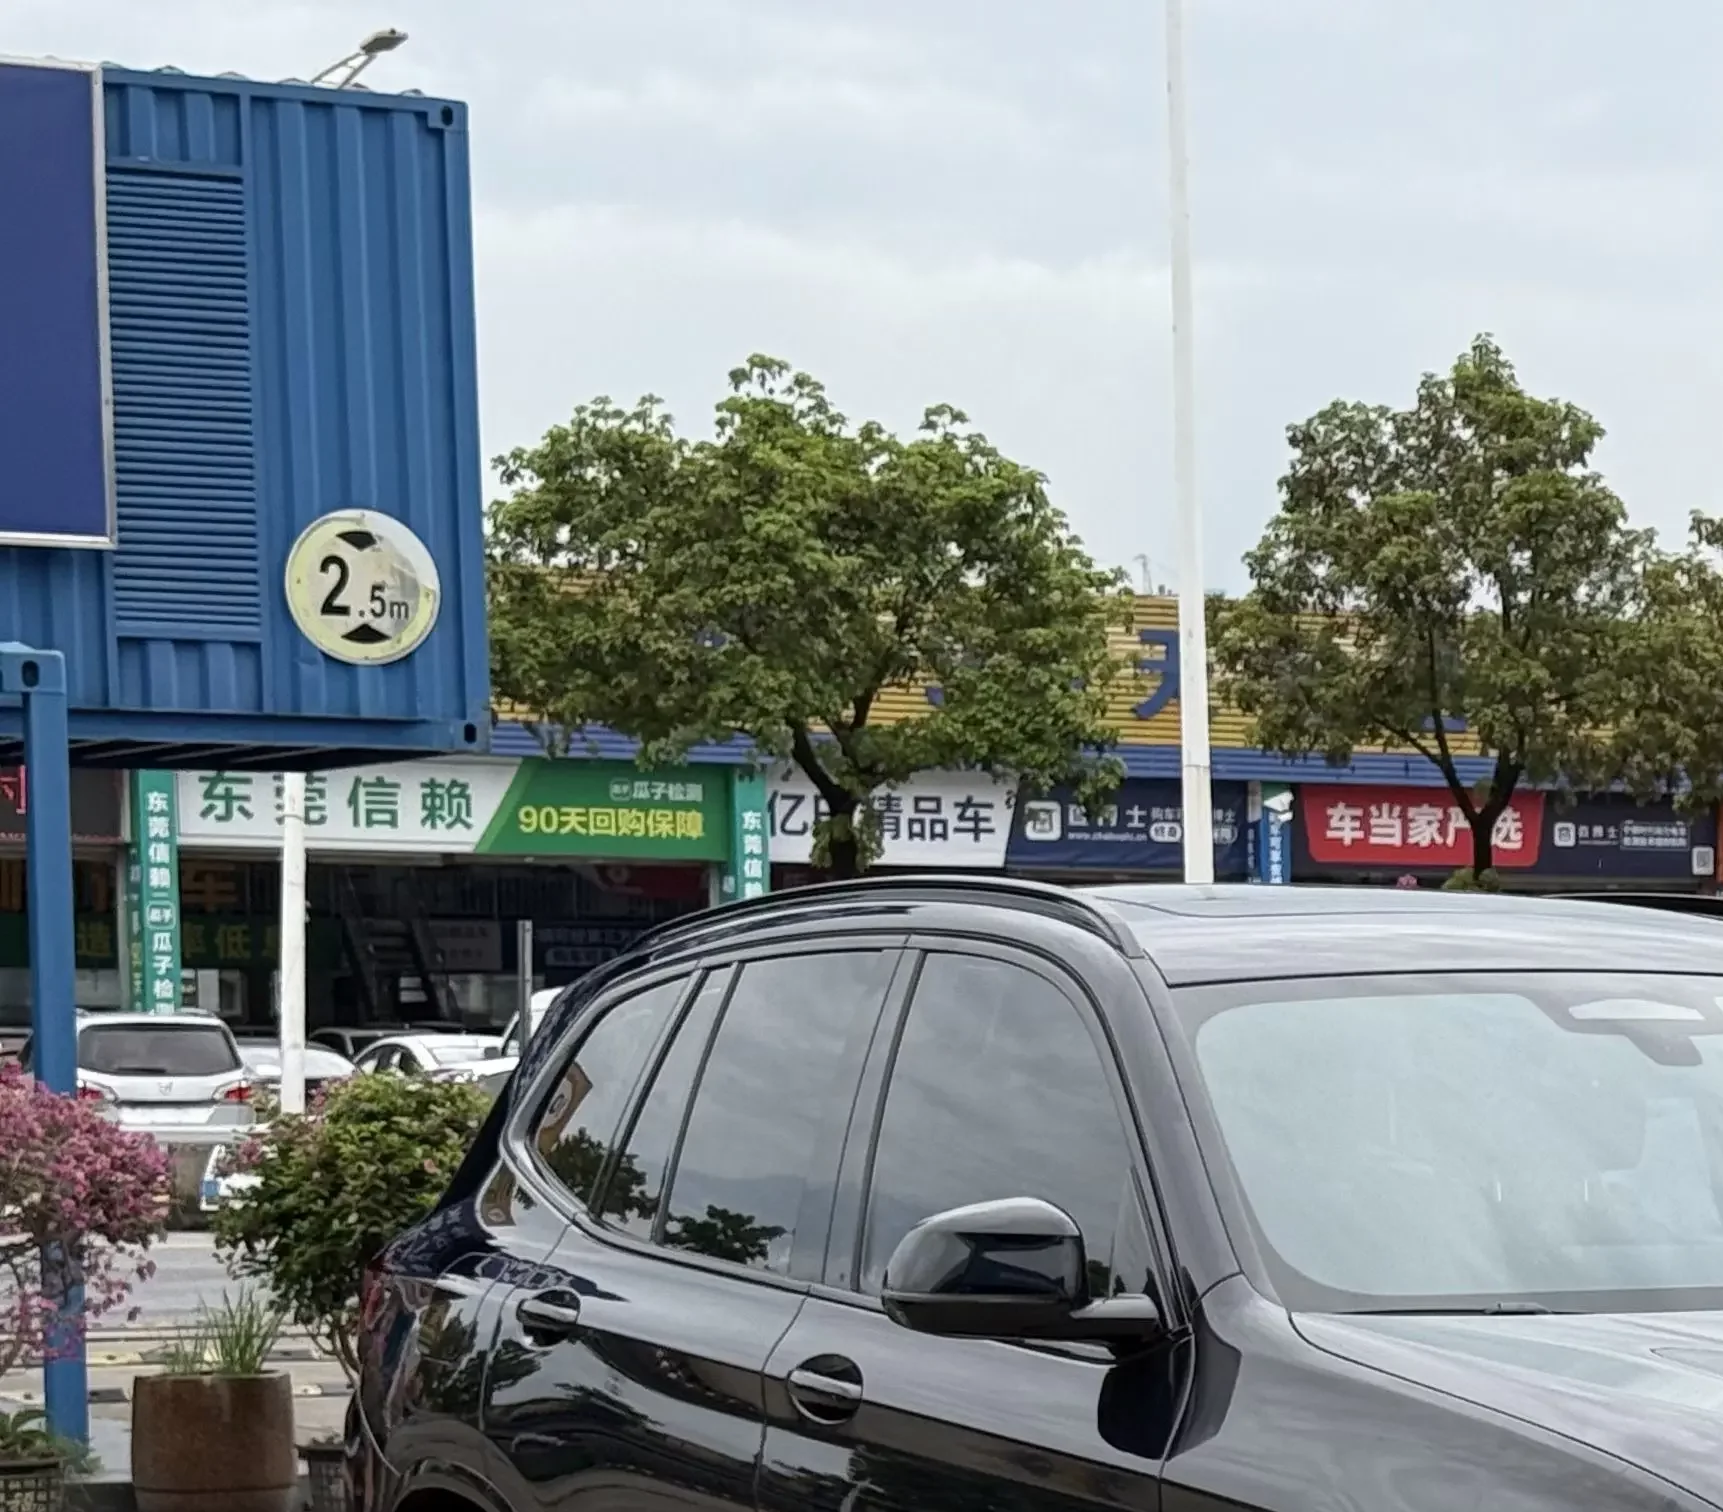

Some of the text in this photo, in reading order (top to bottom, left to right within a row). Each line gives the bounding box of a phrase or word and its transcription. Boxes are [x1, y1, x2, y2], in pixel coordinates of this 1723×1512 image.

[320, 555, 409, 620] 2.5m
[198, 771, 473, 830] 东莞信赖
[518, 806, 704, 839] 90天回购保障
[767, 789, 996, 842] 亿精品车
[1326, 801, 1523, 849] 车当家严选
